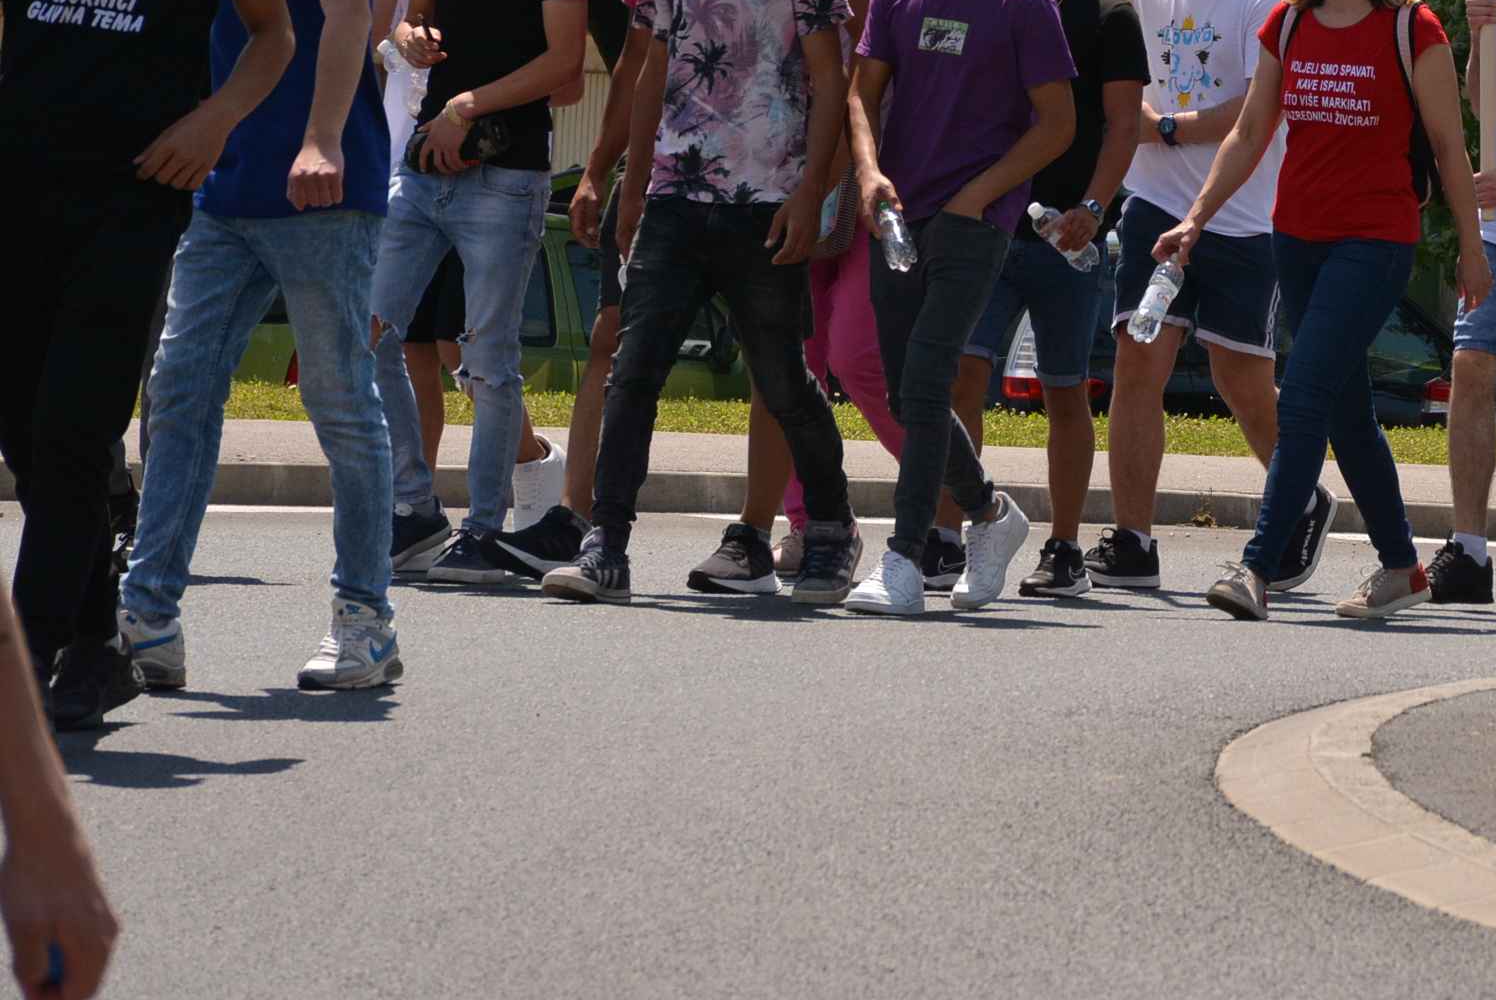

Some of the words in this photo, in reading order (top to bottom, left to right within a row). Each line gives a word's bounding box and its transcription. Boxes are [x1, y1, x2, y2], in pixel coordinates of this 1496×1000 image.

[91, 9, 144, 32] TEMA
[1320, 63, 1339, 76] SMO
[1339, 65, 1376, 80] SPAVATI,
[1296, 78, 1319, 90] KAVE
[1299, 93, 1319, 107] VIŠE
[1321, 96, 1371, 112] MARKIRATI
